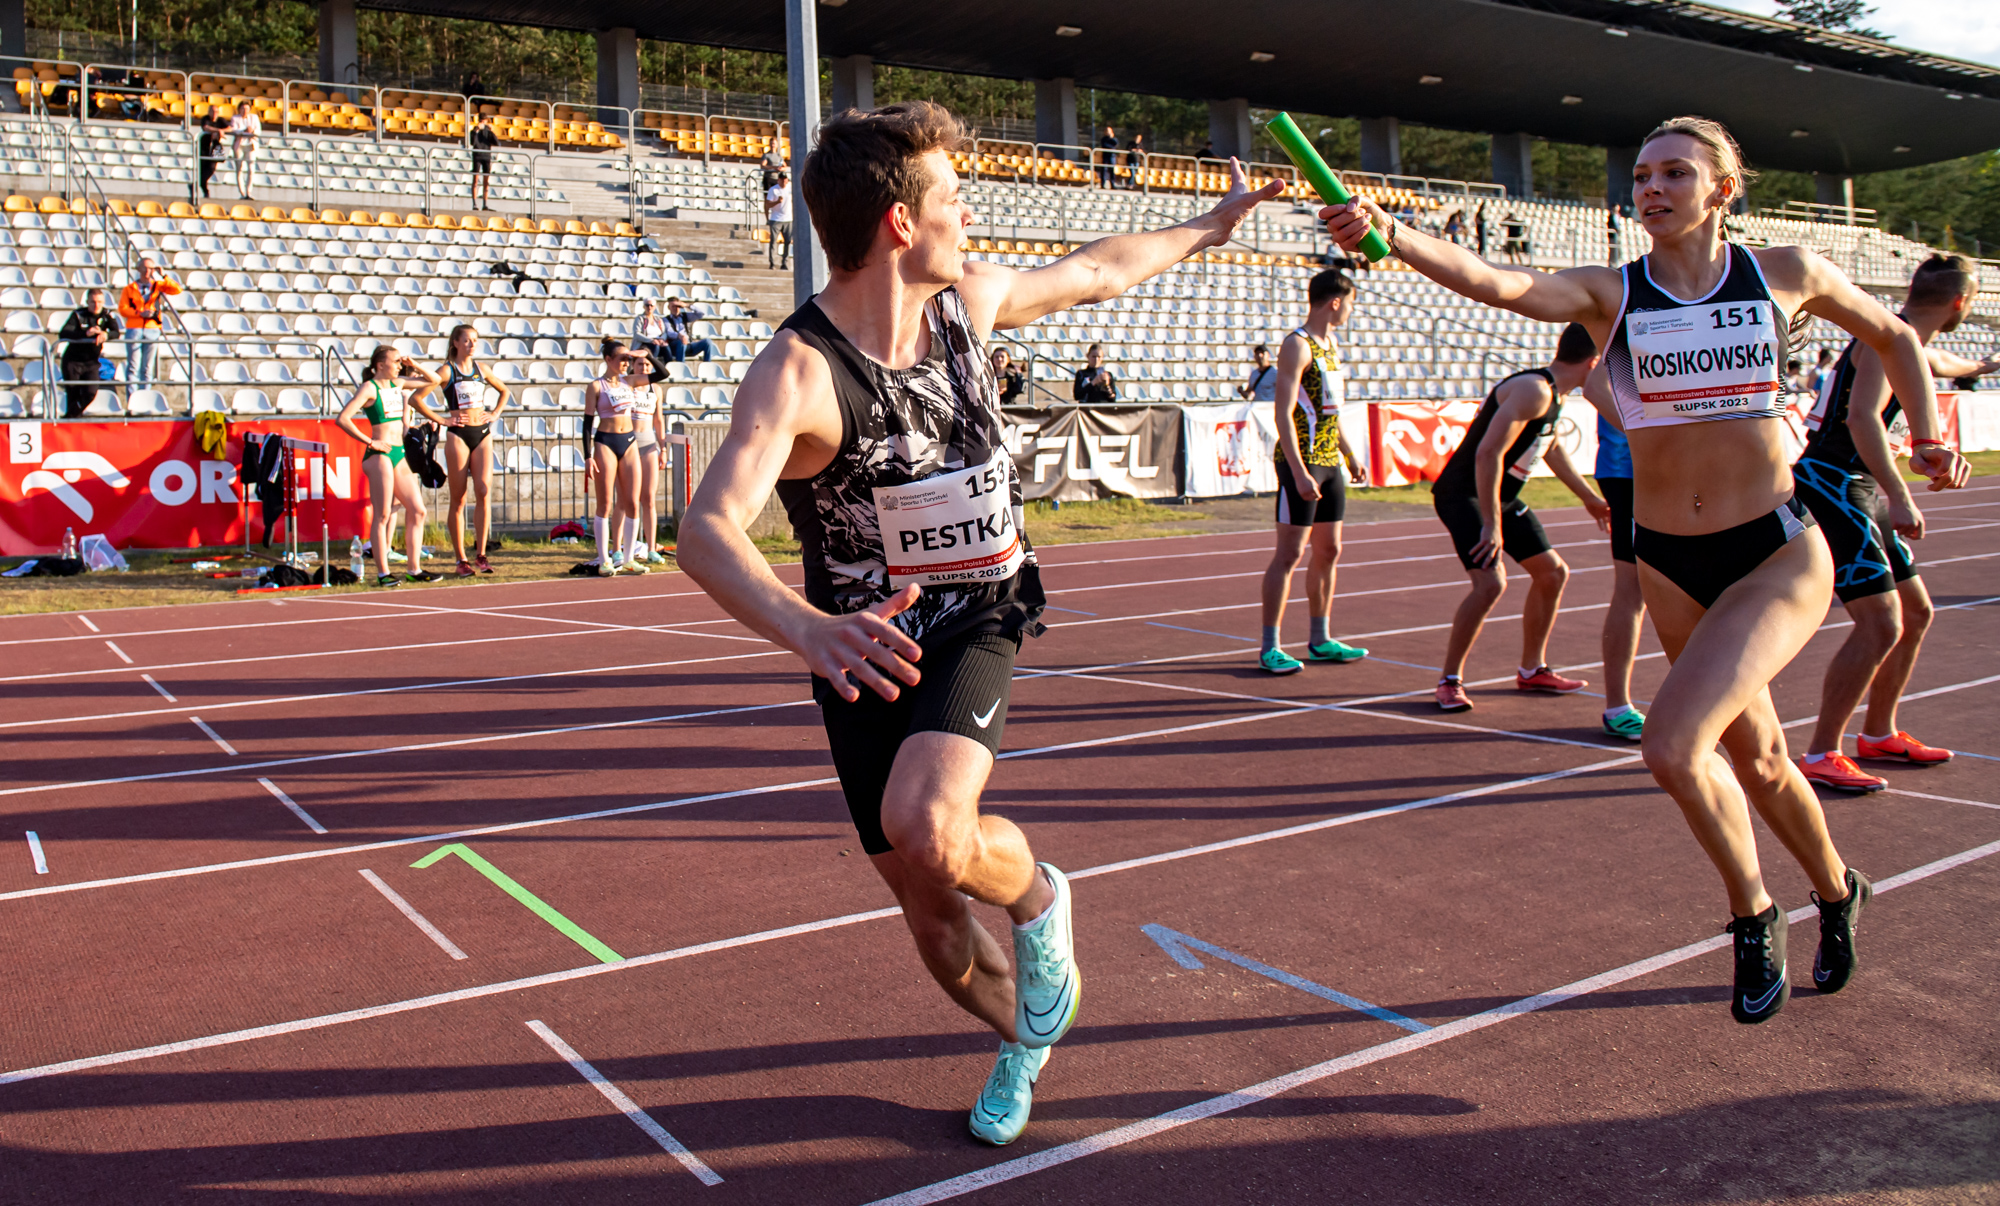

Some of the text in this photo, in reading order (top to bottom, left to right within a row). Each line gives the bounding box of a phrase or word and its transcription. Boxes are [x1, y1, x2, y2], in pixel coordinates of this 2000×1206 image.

[1710, 306, 1762, 330] 151
[1637, 342, 1774, 380] KOSIKOWSKA
[1665, 391, 1704, 400] Mistrzostwa
[1705, 388, 1726, 396] Polski
[1734, 384, 1771, 393] Sztafetach
[1673, 397, 1749, 412] SŁUPSK 2023
[18, 432, 33, 455] 3
[1034, 434, 1159, 483] FUEL
[965, 460, 1005, 499] 153
[899, 491, 936, 501] Ministerstwo
[923, 493, 948, 503] Turystyki
[899, 507, 1012, 553] PESTKA
[919, 564, 963, 572] Mistrzostwa
[963, 560, 985, 568] Polski
[928, 565, 1008, 581] SŁUPSK 2023
